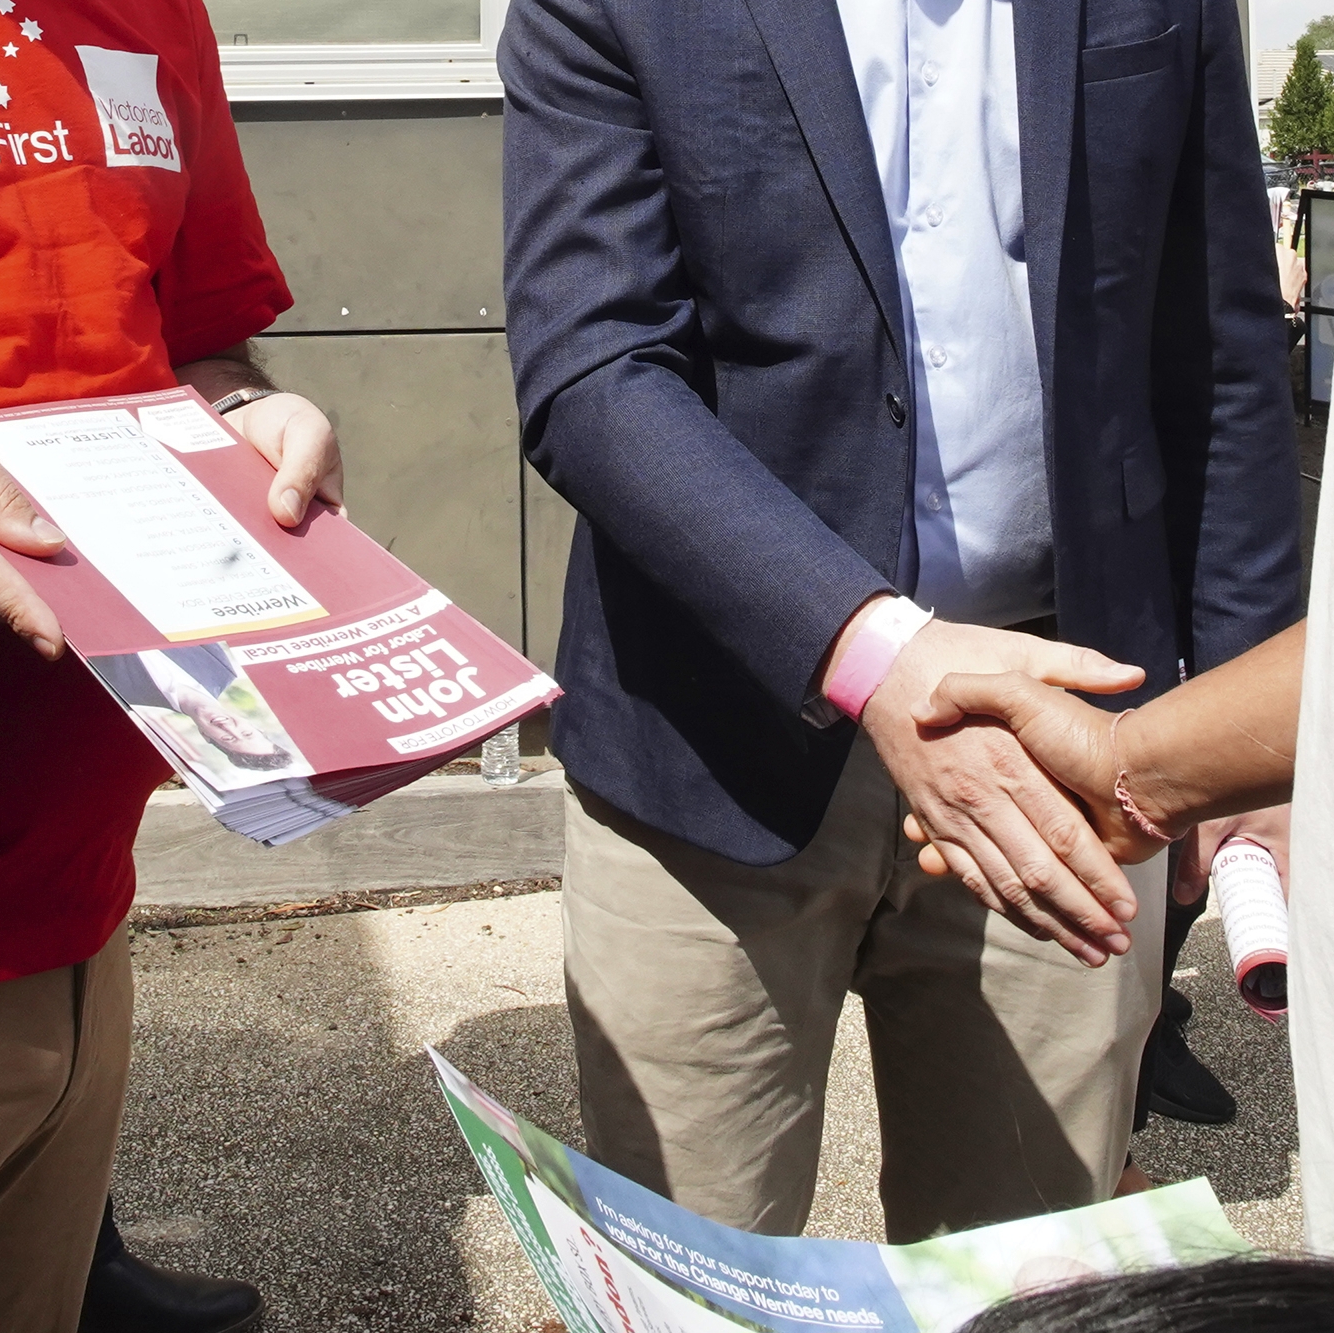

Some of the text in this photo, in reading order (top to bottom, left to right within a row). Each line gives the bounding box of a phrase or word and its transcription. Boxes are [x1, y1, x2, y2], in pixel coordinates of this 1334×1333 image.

[99, 96, 167, 127] Victorian
[110, 122, 175, 161] Labor
[26, 431, 122, 446] LISTER, John
[125, 427, 137, 436] 1
[191, 493, 201, 501] 5
[202, 508, 218, 517] 10
[218, 522, 228, 531] 3
[232, 537, 242, 546] 9
[246, 552, 256, 560] 8
[260, 567, 271, 575] 2
[177, 583, 294, 608] NUMBER EVERY BOX
[211, 593, 308, 617] Werribee
[243, 604, 422, 661] A True Werribee Local
[286, 623, 438, 674] Labor for Werribee
[331, 637, 469, 699] Lister
[371, 666, 487, 724] John
[397, 696, 517, 749] HOW TO VOTE FOR
[1220, 854, 1239, 869] do
[595, 1196, 839, 1303] I'm asking for your support today to
[604, 1221, 884, 1325] vote For the Change Werribee needs.
